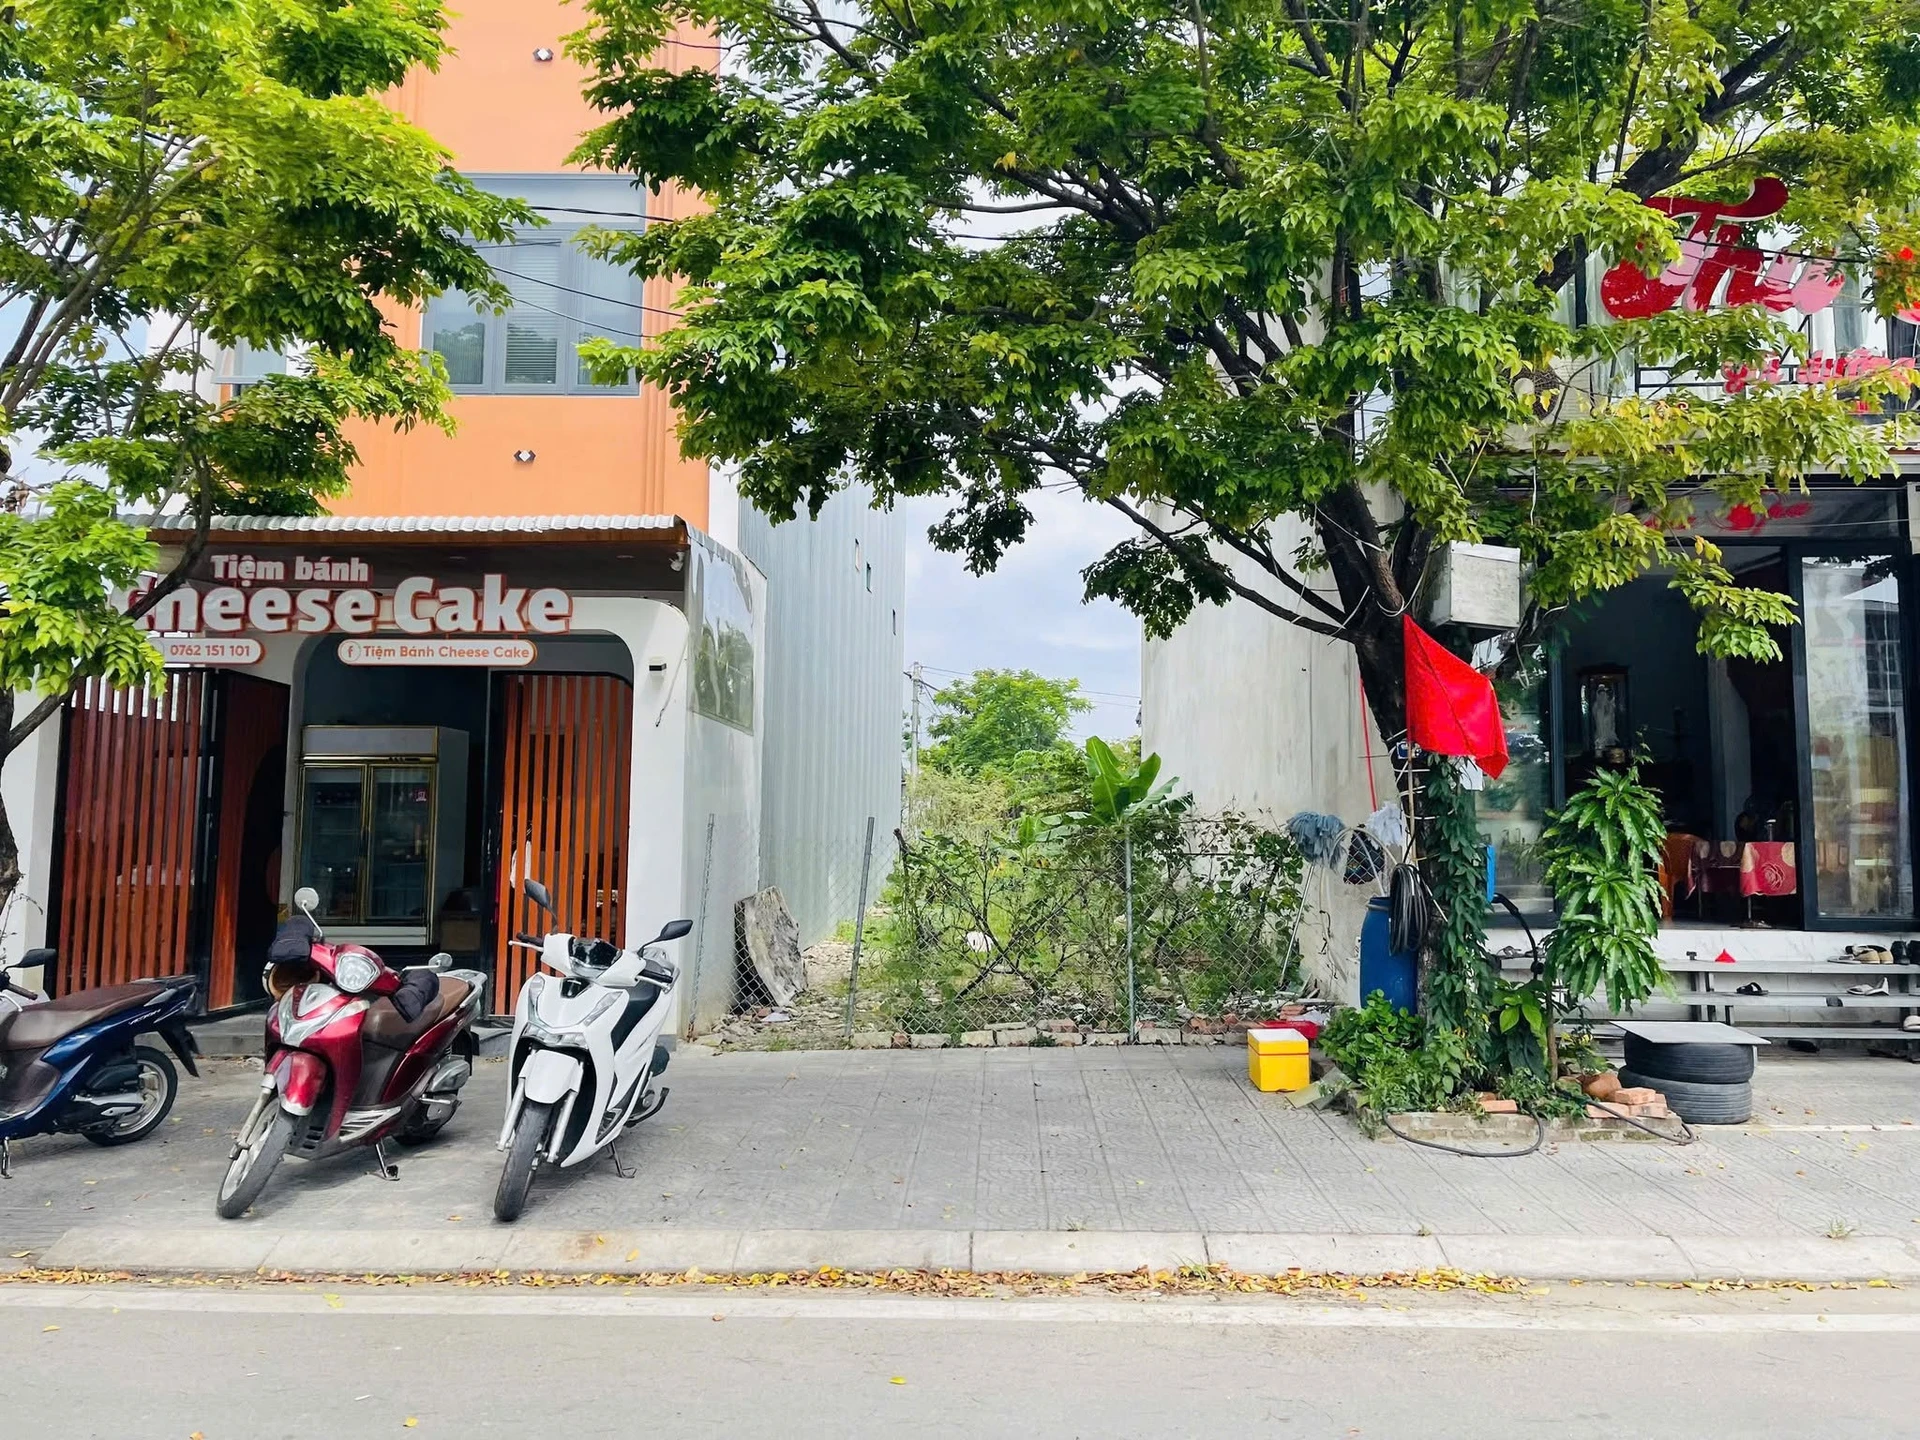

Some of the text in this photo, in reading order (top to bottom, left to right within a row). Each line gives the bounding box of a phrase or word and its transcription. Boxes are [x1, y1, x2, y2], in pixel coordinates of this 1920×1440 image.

[210, 554, 371, 587] Tiệm bánh
[394, 573, 571, 634] Cake
[170, 644, 250, 656] 0762 151 101
[363, 645, 396, 660] Tiệm
[400, 644, 435, 658] Bánh
[439, 645, 489, 658] Cheese
[494, 645, 530, 658] Cake
